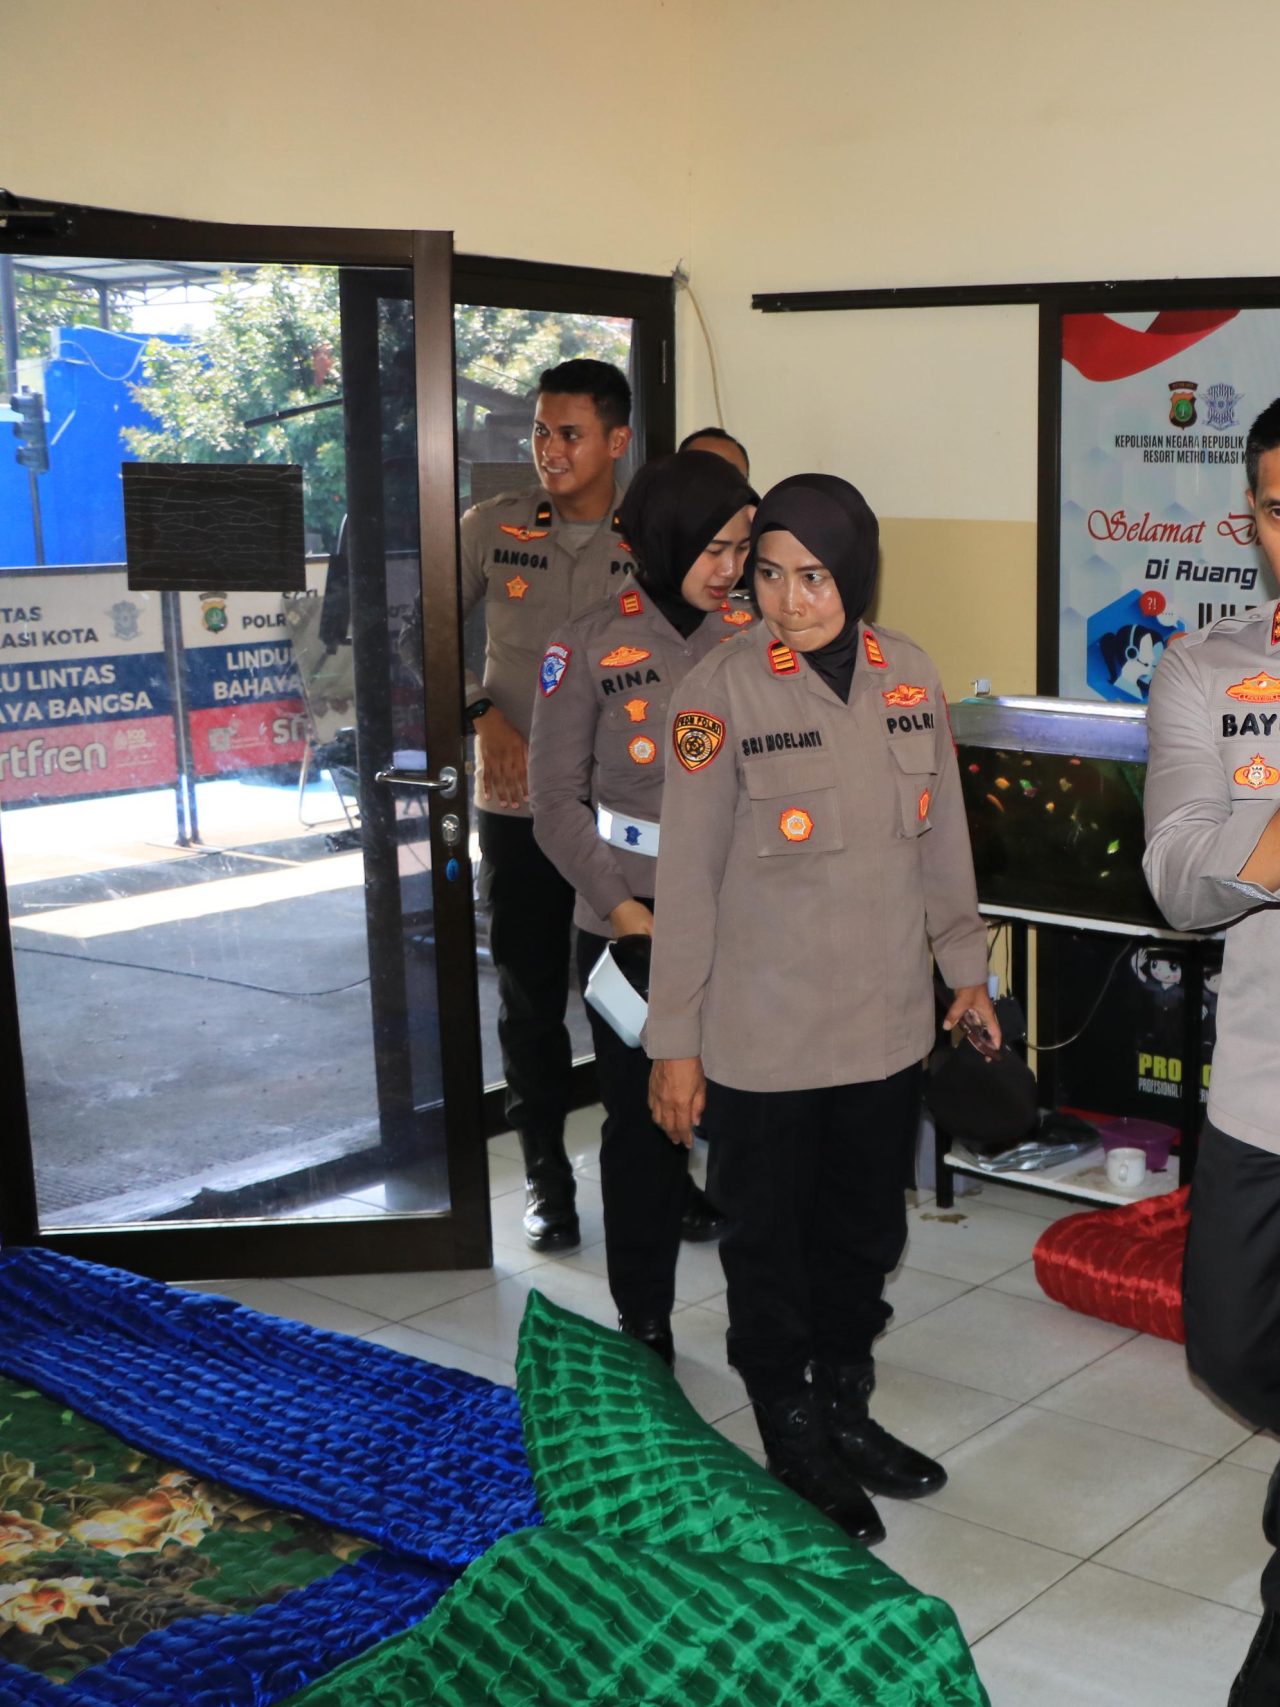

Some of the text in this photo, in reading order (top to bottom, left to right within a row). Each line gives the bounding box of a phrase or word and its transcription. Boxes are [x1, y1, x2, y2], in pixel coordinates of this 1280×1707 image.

[1115, 434, 1244, 449] KEPOLISIAN NEGARA REPUBLIK
[1143, 450, 1175, 463] RESORT
[1177, 450, 1205, 463] METRO
[1208, 451, 1239, 464] BEKASI
[1088, 509, 1206, 544] Selamat
[1145, 559, 1258, 590] Di Ruang
[43, 628, 99, 646] KOTA
[226, 648, 297, 671] LINDU
[0, 664, 116, 692] U LINTAS
[601, 668, 661, 696] RINA
[49, 691, 153, 719] BANGSA
[886, 712, 934, 734] POLRI
[741, 737, 764, 756] SRI
[1138, 1052, 1182, 1082] PRO
